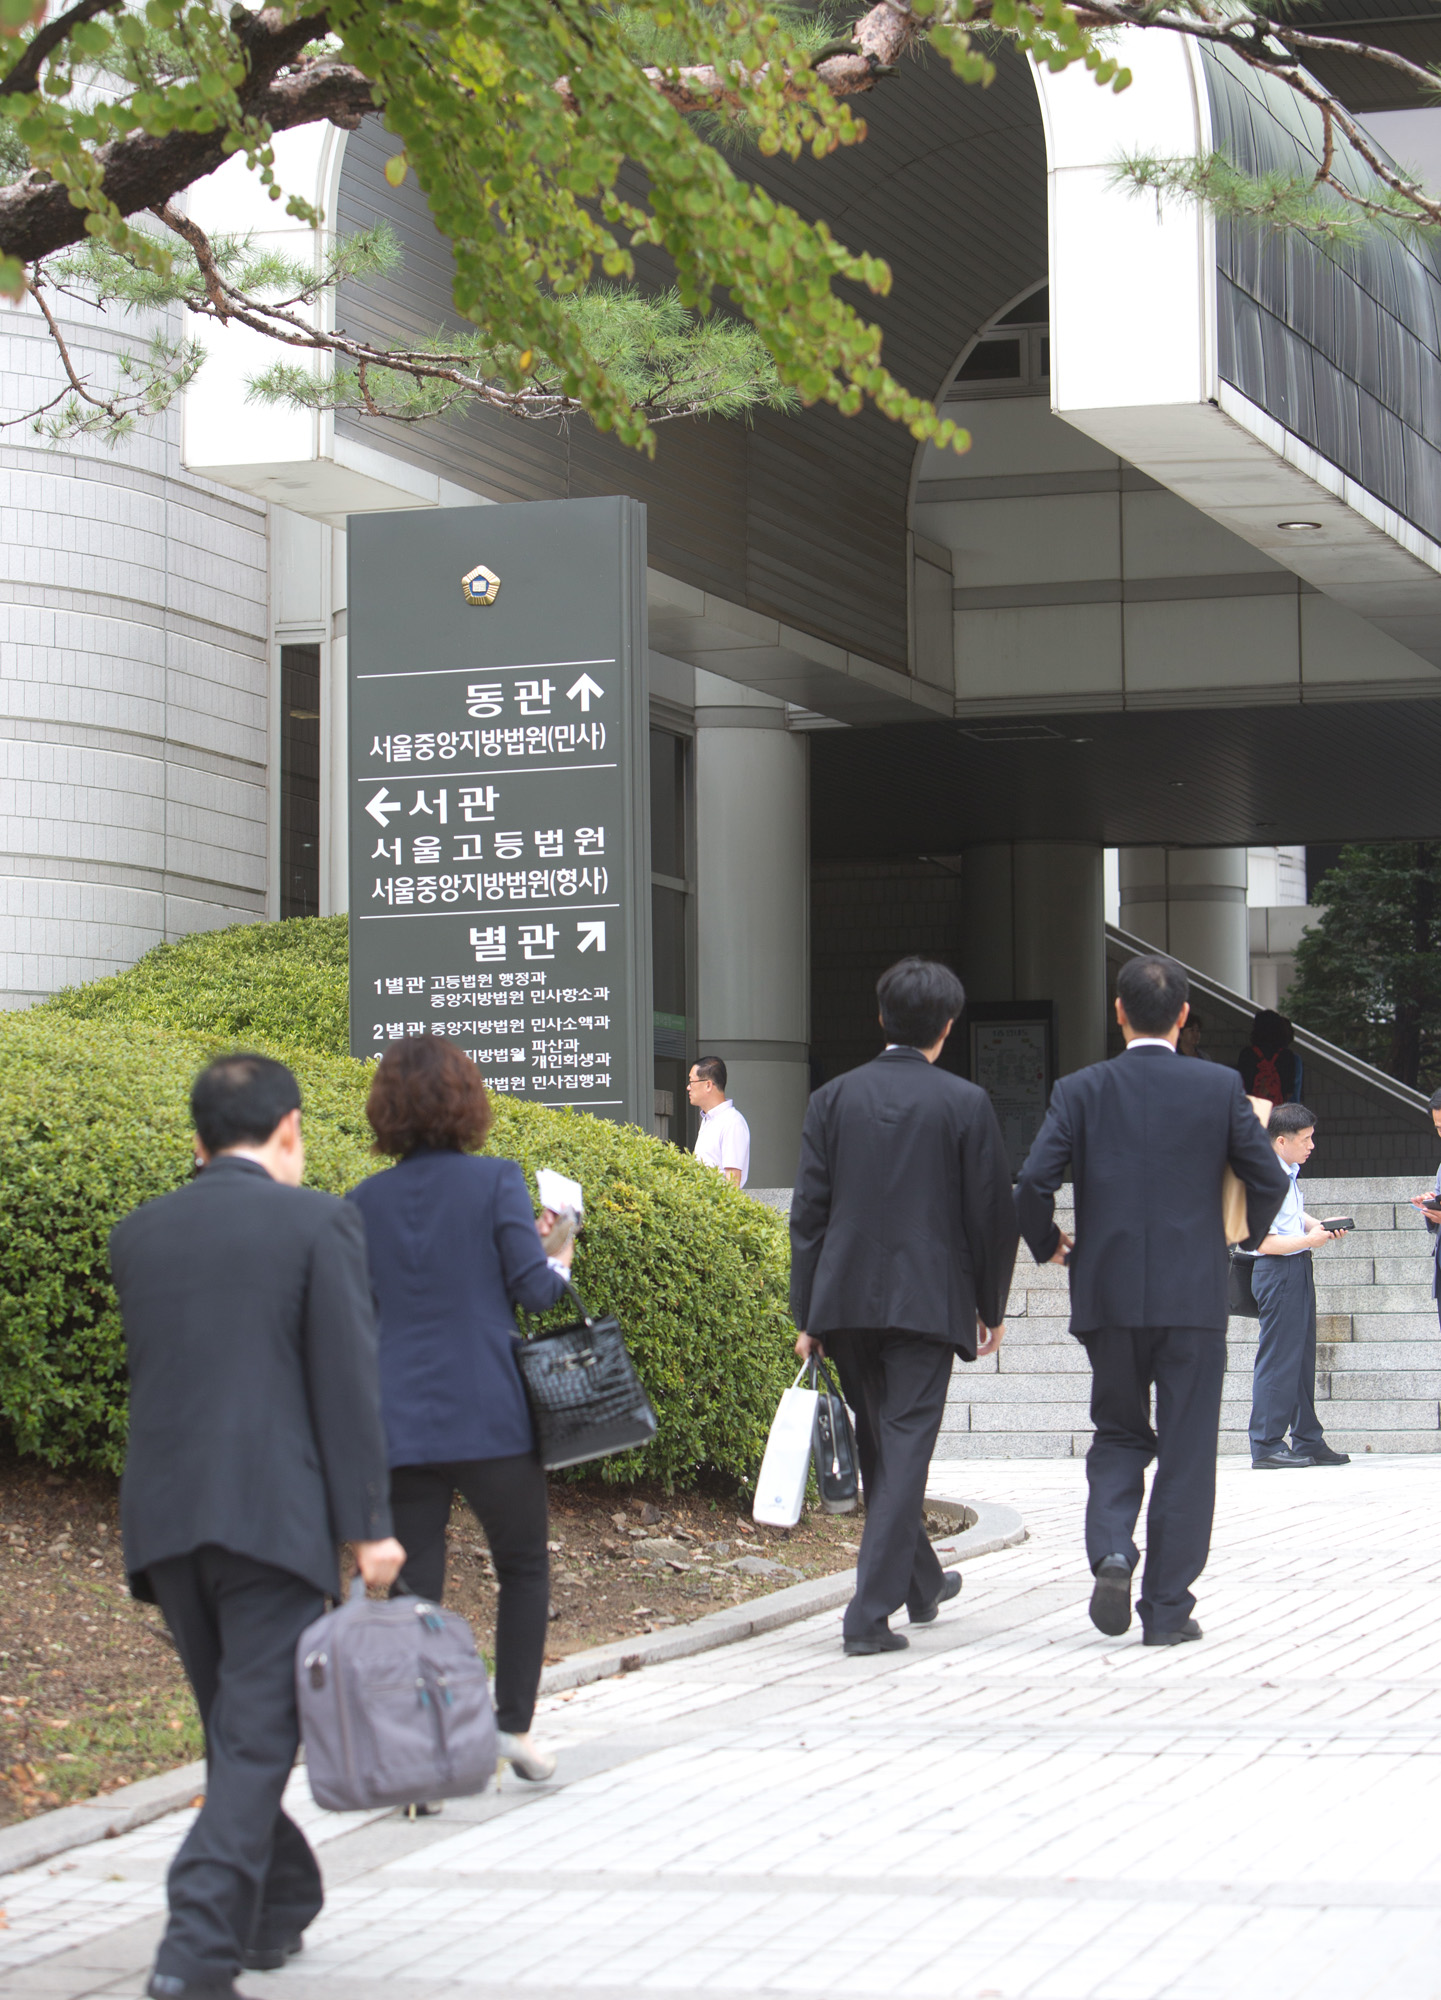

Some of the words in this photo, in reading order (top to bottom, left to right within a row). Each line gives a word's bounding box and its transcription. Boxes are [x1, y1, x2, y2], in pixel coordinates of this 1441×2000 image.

[465, 678, 556, 719] 동관
[369, 722, 607, 763] 서울중앙지방법원(민사)
[408, 785, 500, 825] 서관
[371, 826, 605, 866] 서울고등법원
[371, 866, 609, 906] 서울중앙지방법원(형사)
[469, 923, 560, 963] 별관
[373, 976, 425, 995] 1별관
[430, 974, 493, 990] 고등법원
[498, 971, 547, 987] 행정과
[430, 991, 525, 1009] 중앙지방법원
[530, 987, 610, 1005] 민사항소과
[430, 1018, 526, 1037] 중앙지방법원
[530, 1015, 611, 1034] 민사소액과
[531, 1038, 580, 1054] 파산과
[531, 1052, 612, 1070] 개인회생과
[531, 1073, 612, 1091] 민사집행과
